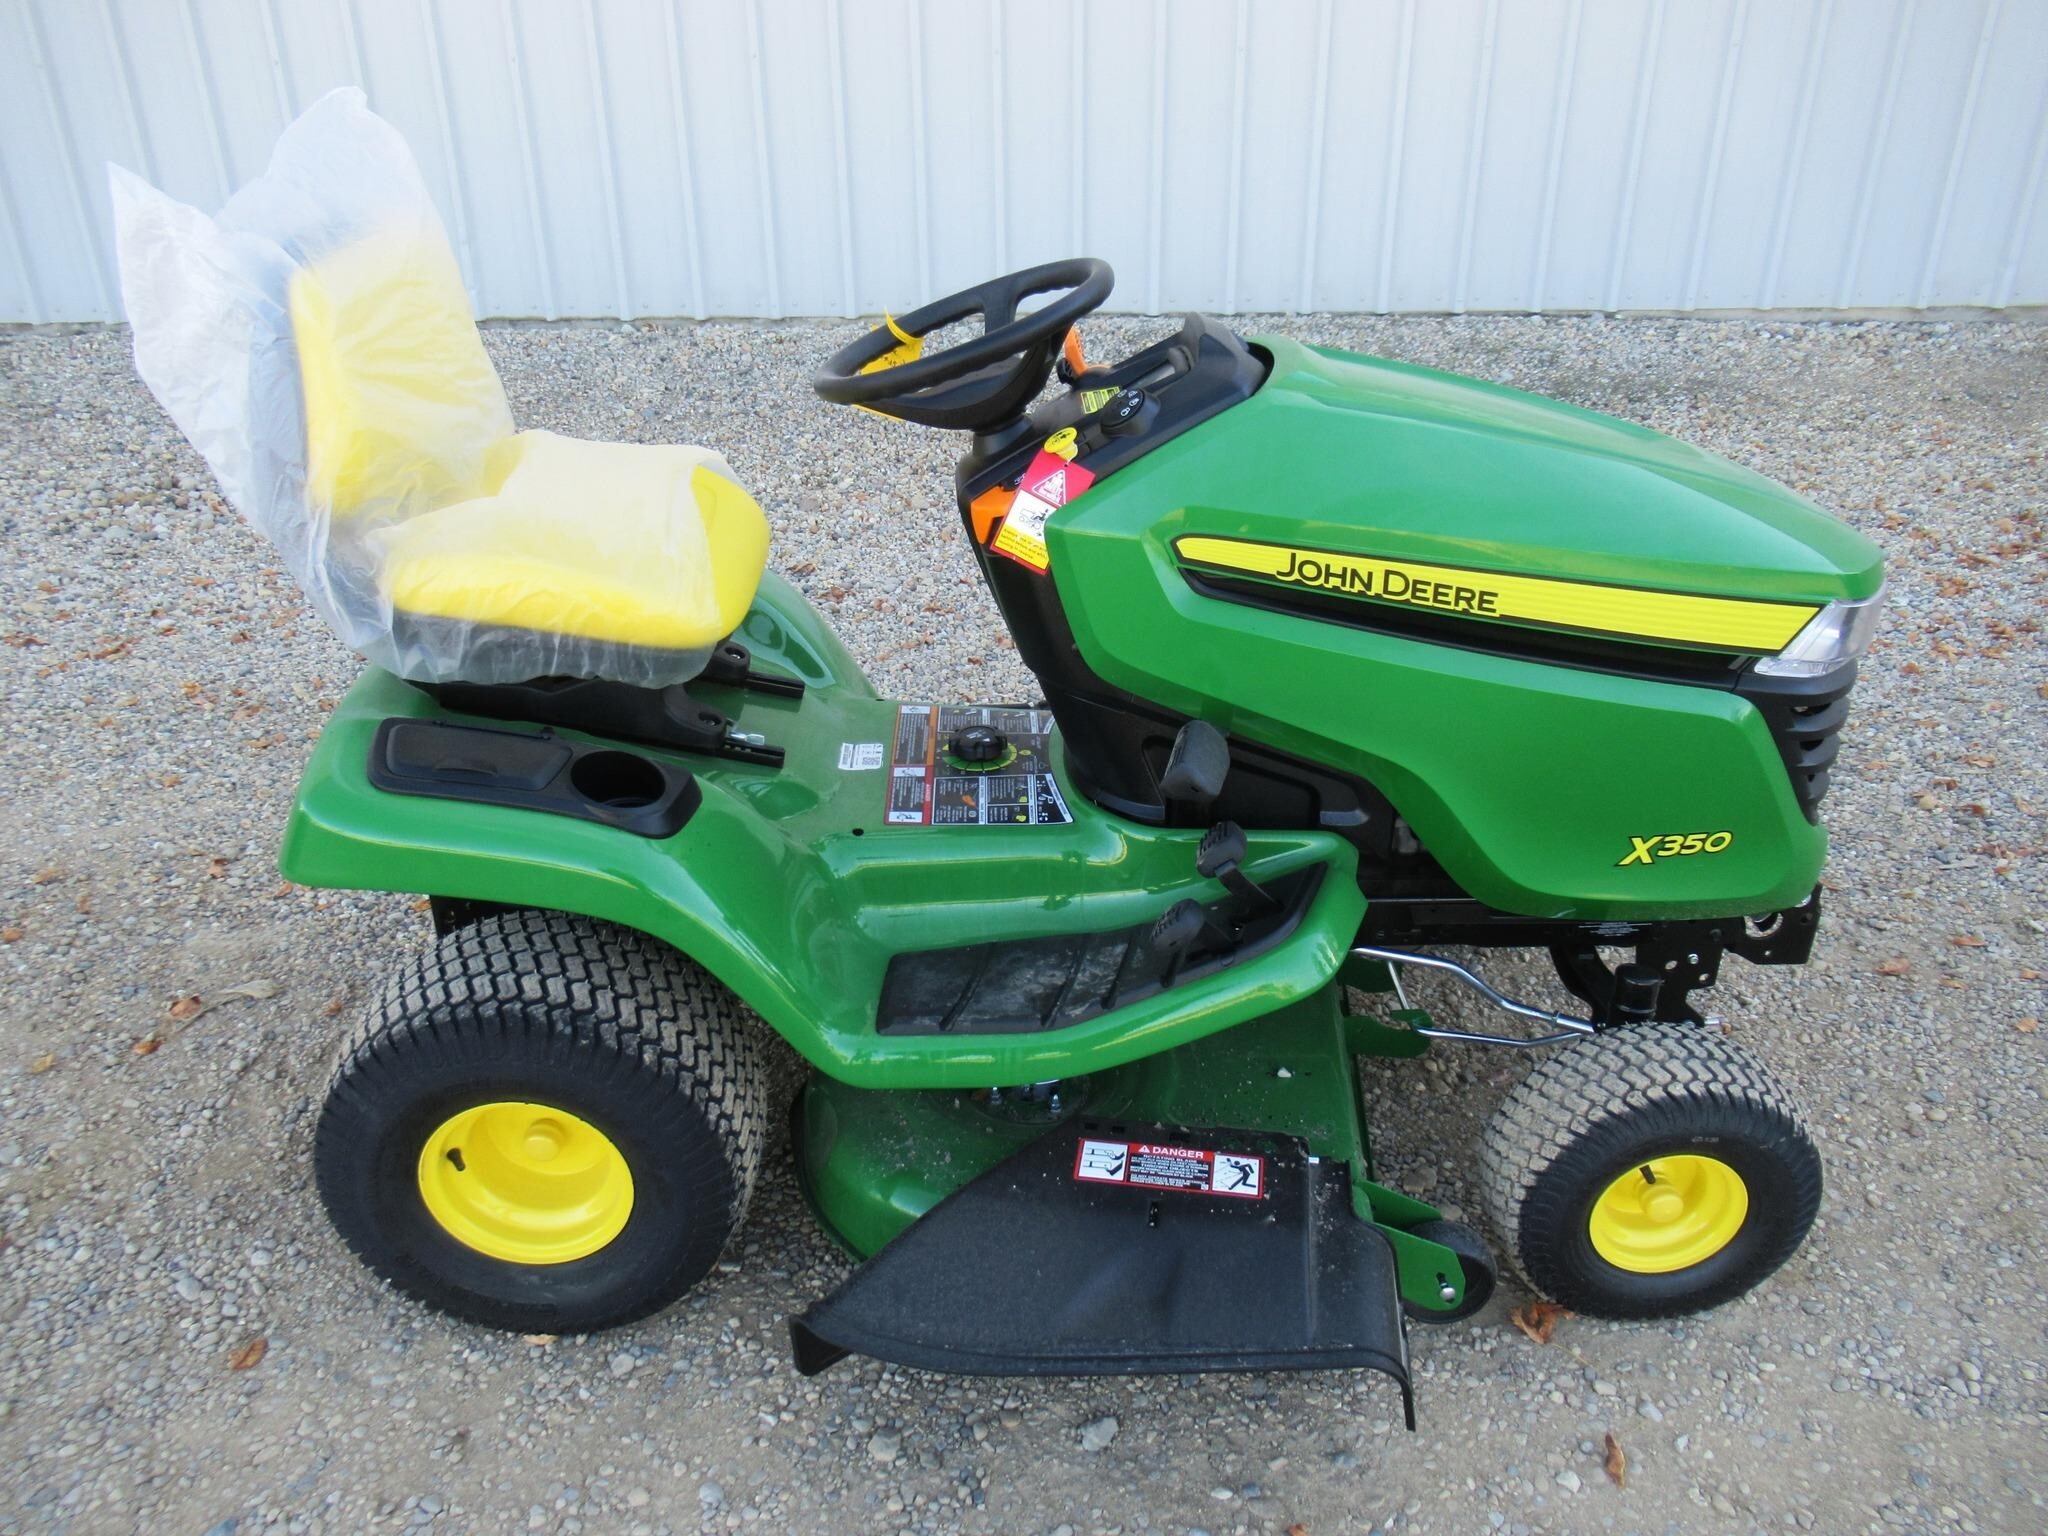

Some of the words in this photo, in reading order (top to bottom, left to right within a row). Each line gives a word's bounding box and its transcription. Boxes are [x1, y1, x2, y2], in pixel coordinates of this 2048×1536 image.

[1276, 552, 1374, 593] JOHN
[1382, 569, 1499, 614] DEERE
[1615, 830, 1733, 866] X350
[1152, 1146, 1204, 1159] DANGER
